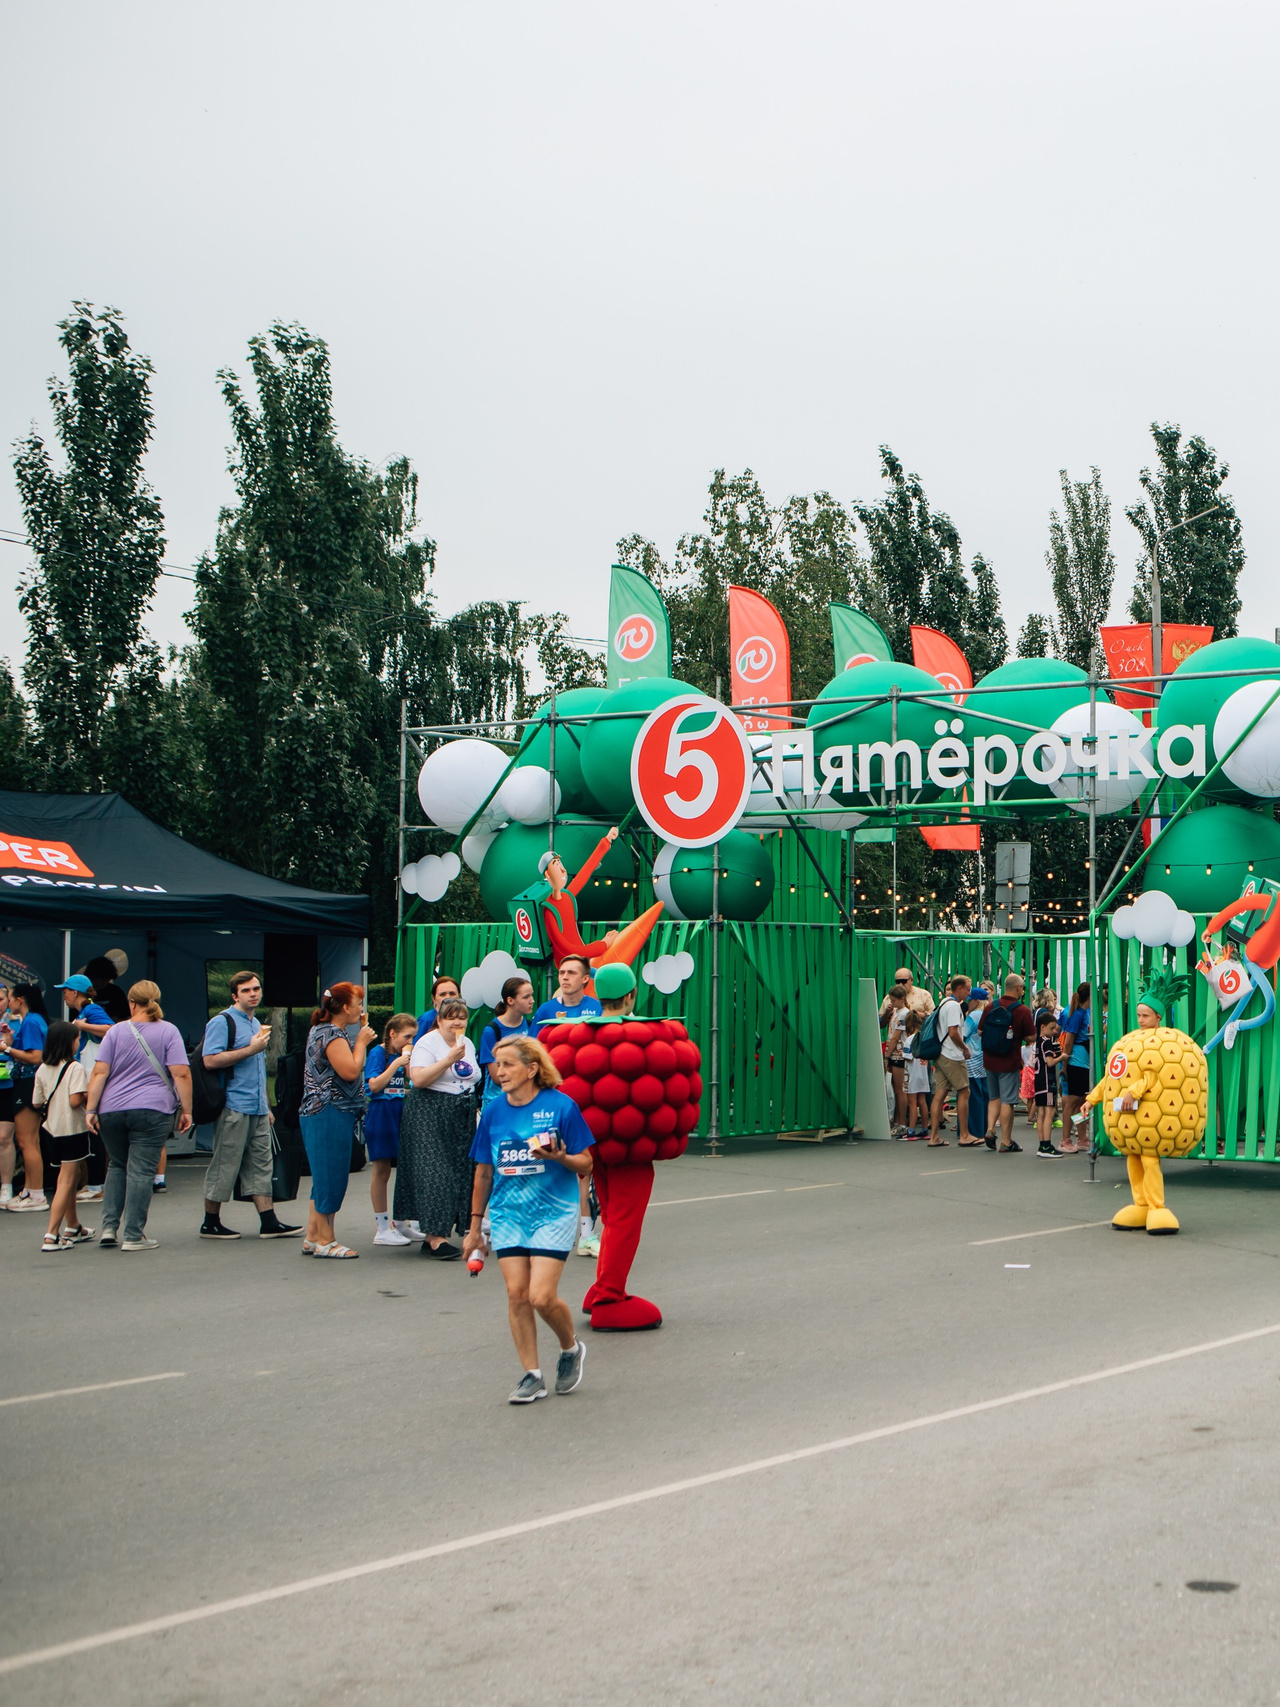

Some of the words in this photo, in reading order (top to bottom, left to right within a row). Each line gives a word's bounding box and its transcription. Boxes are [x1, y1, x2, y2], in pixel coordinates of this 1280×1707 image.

[1110, 635, 1149, 654] Омск
[1114, 657, 1146, 675] 308
[663, 704, 724, 819] 5
[771, 718, 1206, 806] Пятёрочка
